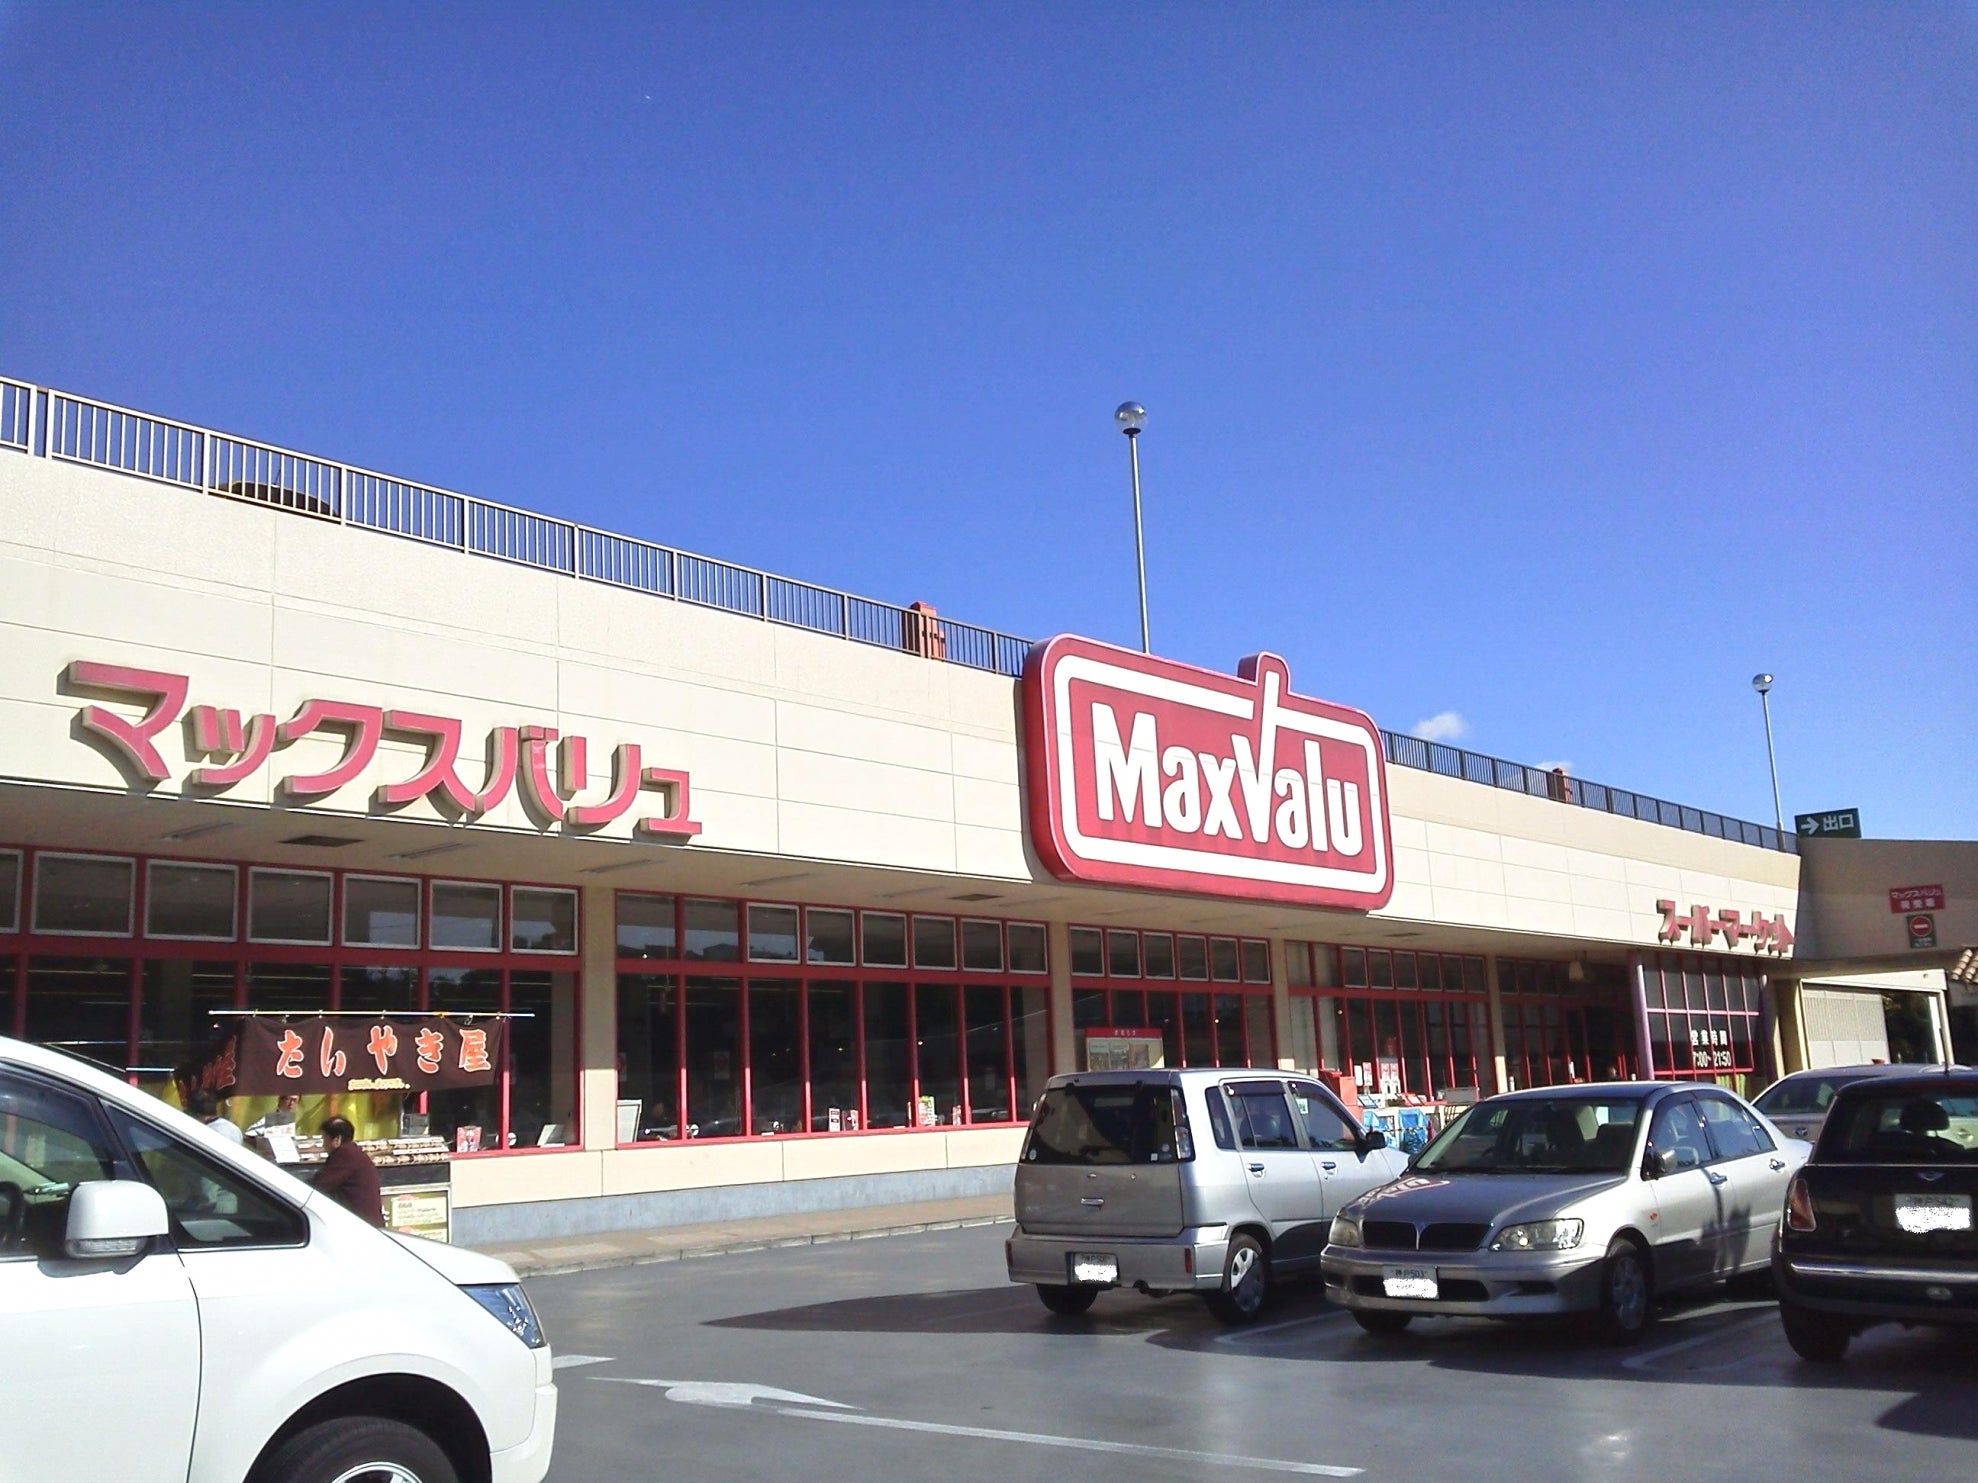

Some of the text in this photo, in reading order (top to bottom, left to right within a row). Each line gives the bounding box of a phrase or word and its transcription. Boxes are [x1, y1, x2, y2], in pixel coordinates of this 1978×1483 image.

[69, 660, 702, 835] マックスバリュ
[1090, 670, 1364, 857] MaxValu
[1822, 814, 1855, 831] 出口
[276, 1025, 492, 1078] たいやき屋
